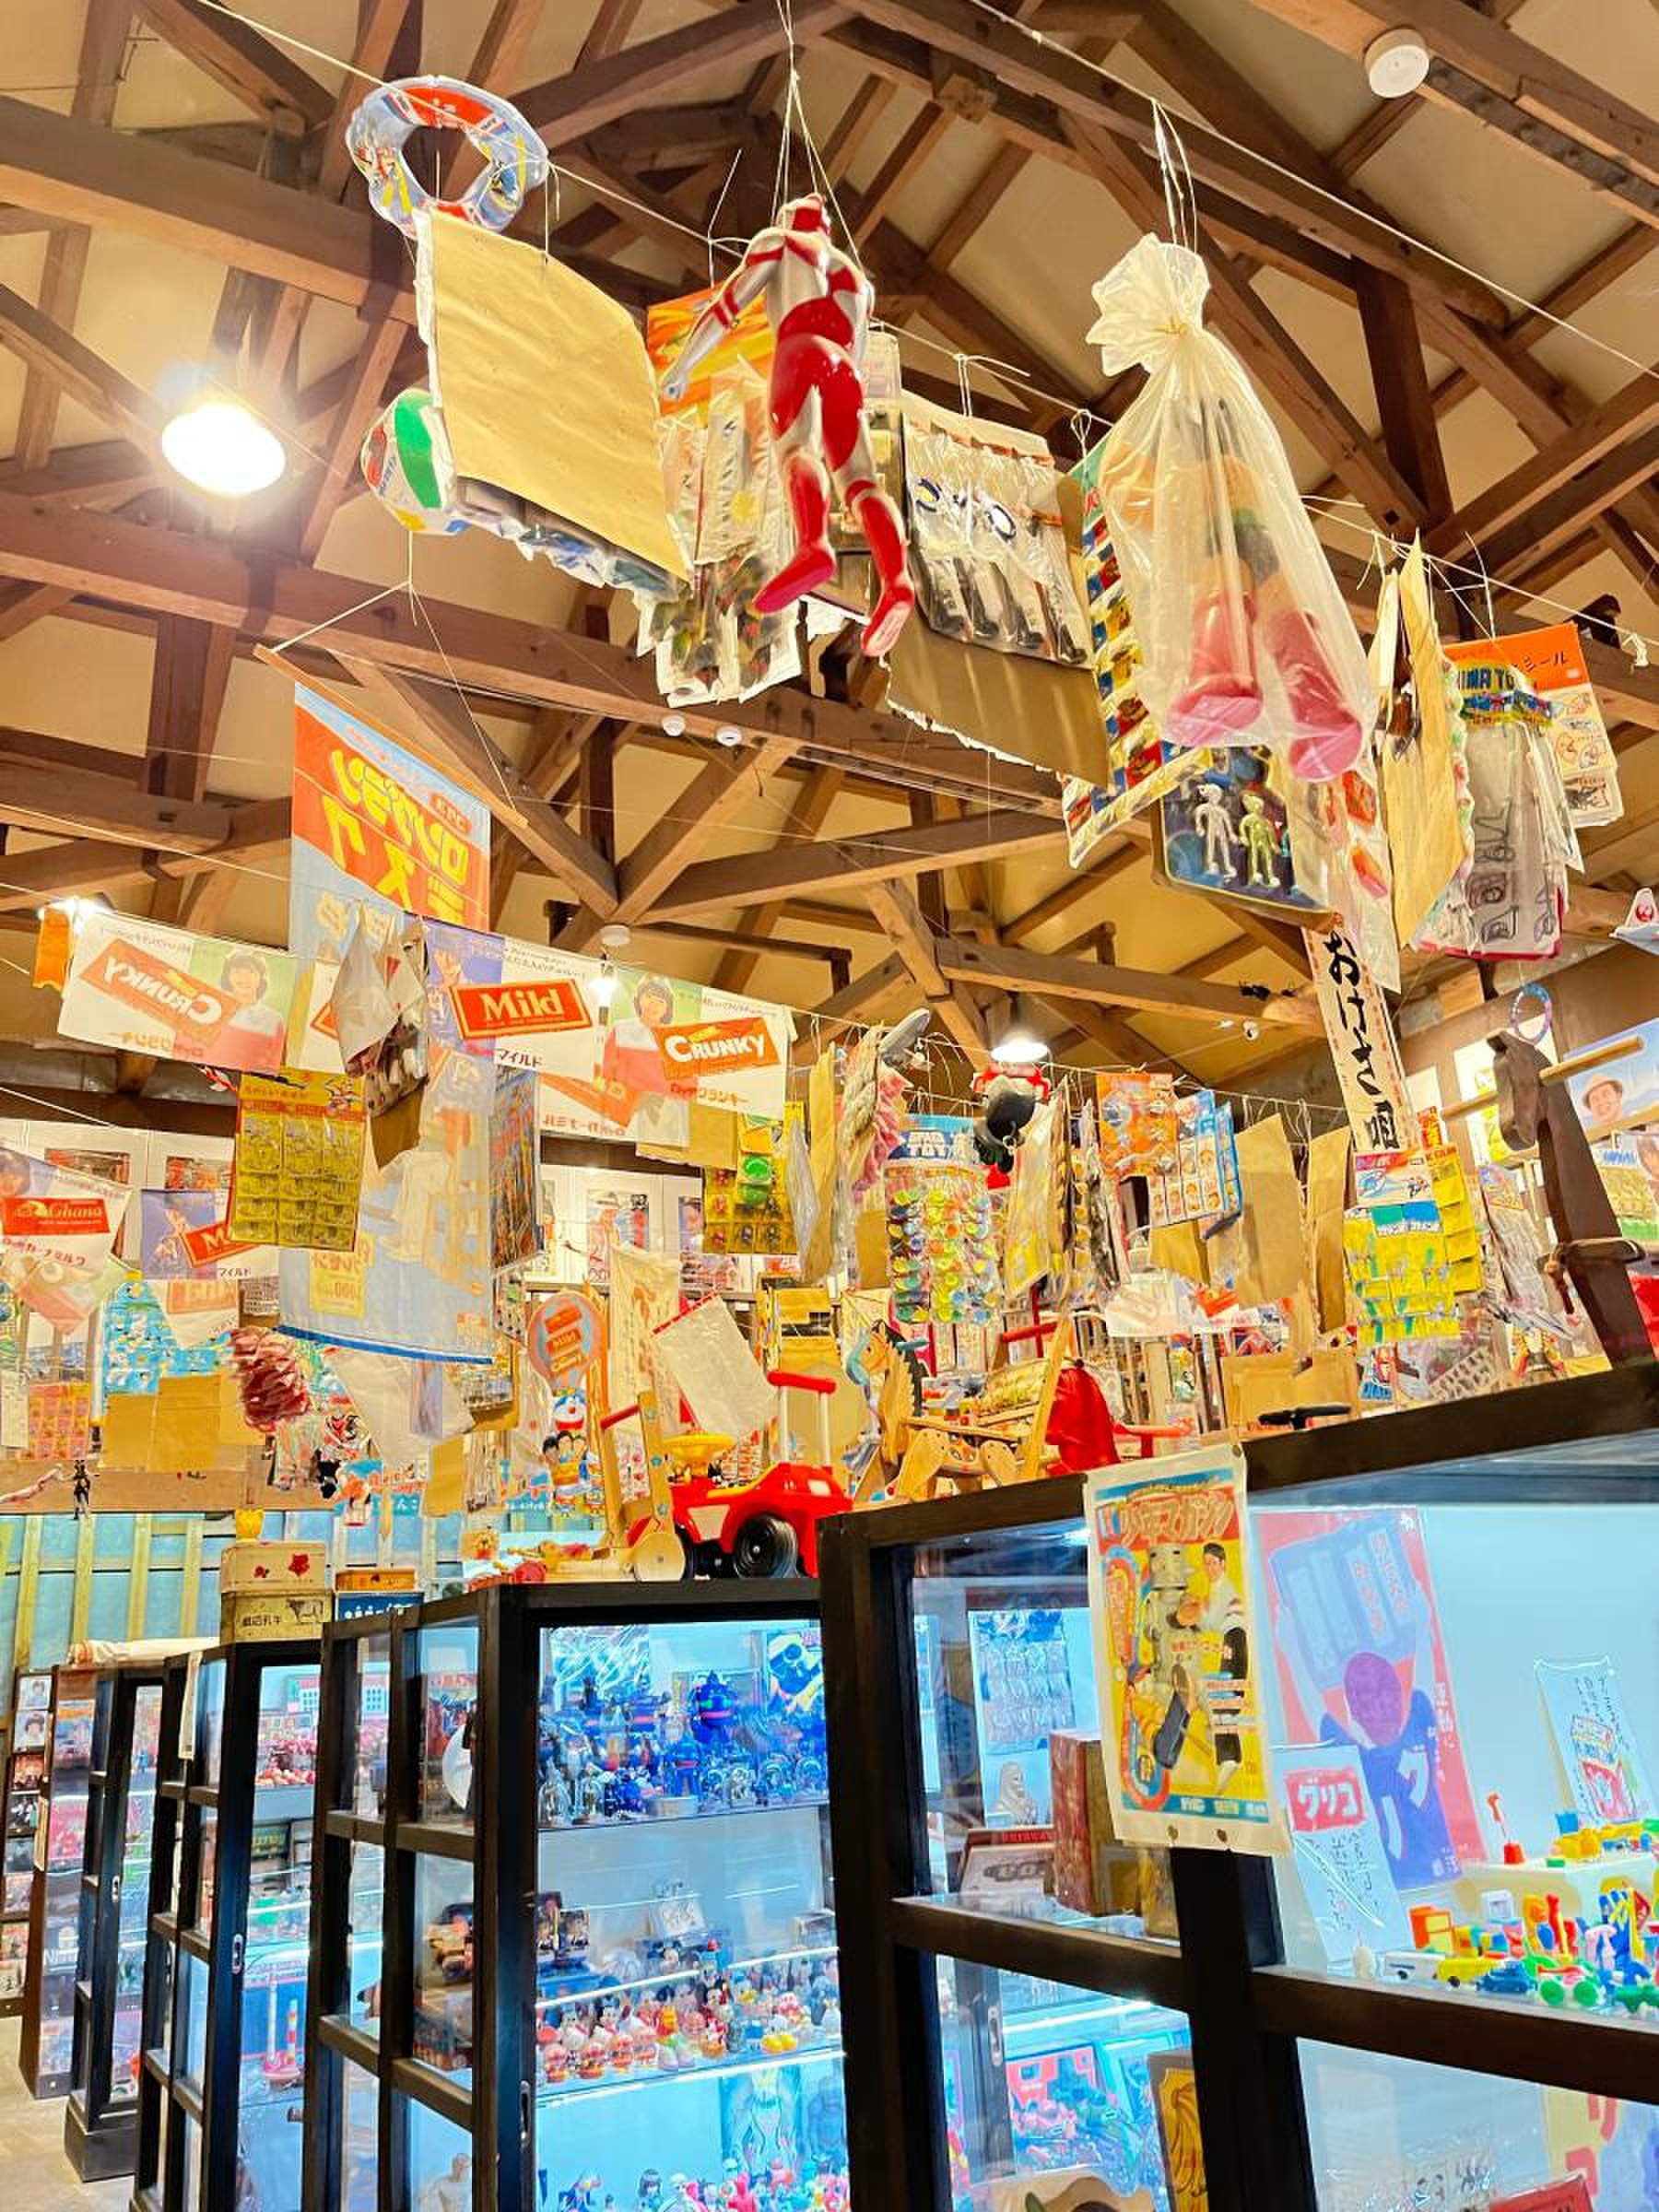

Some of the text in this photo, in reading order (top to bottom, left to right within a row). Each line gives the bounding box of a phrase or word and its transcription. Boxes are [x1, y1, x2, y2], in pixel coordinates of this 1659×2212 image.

[480, 989, 564, 1022] Mild
[499, 1049, 543, 1068] マイルド
[665, 1034, 765, 1063] CRUNKY
[49, 1201, 103, 1218] Ghana
[1299, 1778, 1358, 1819] グリコ
